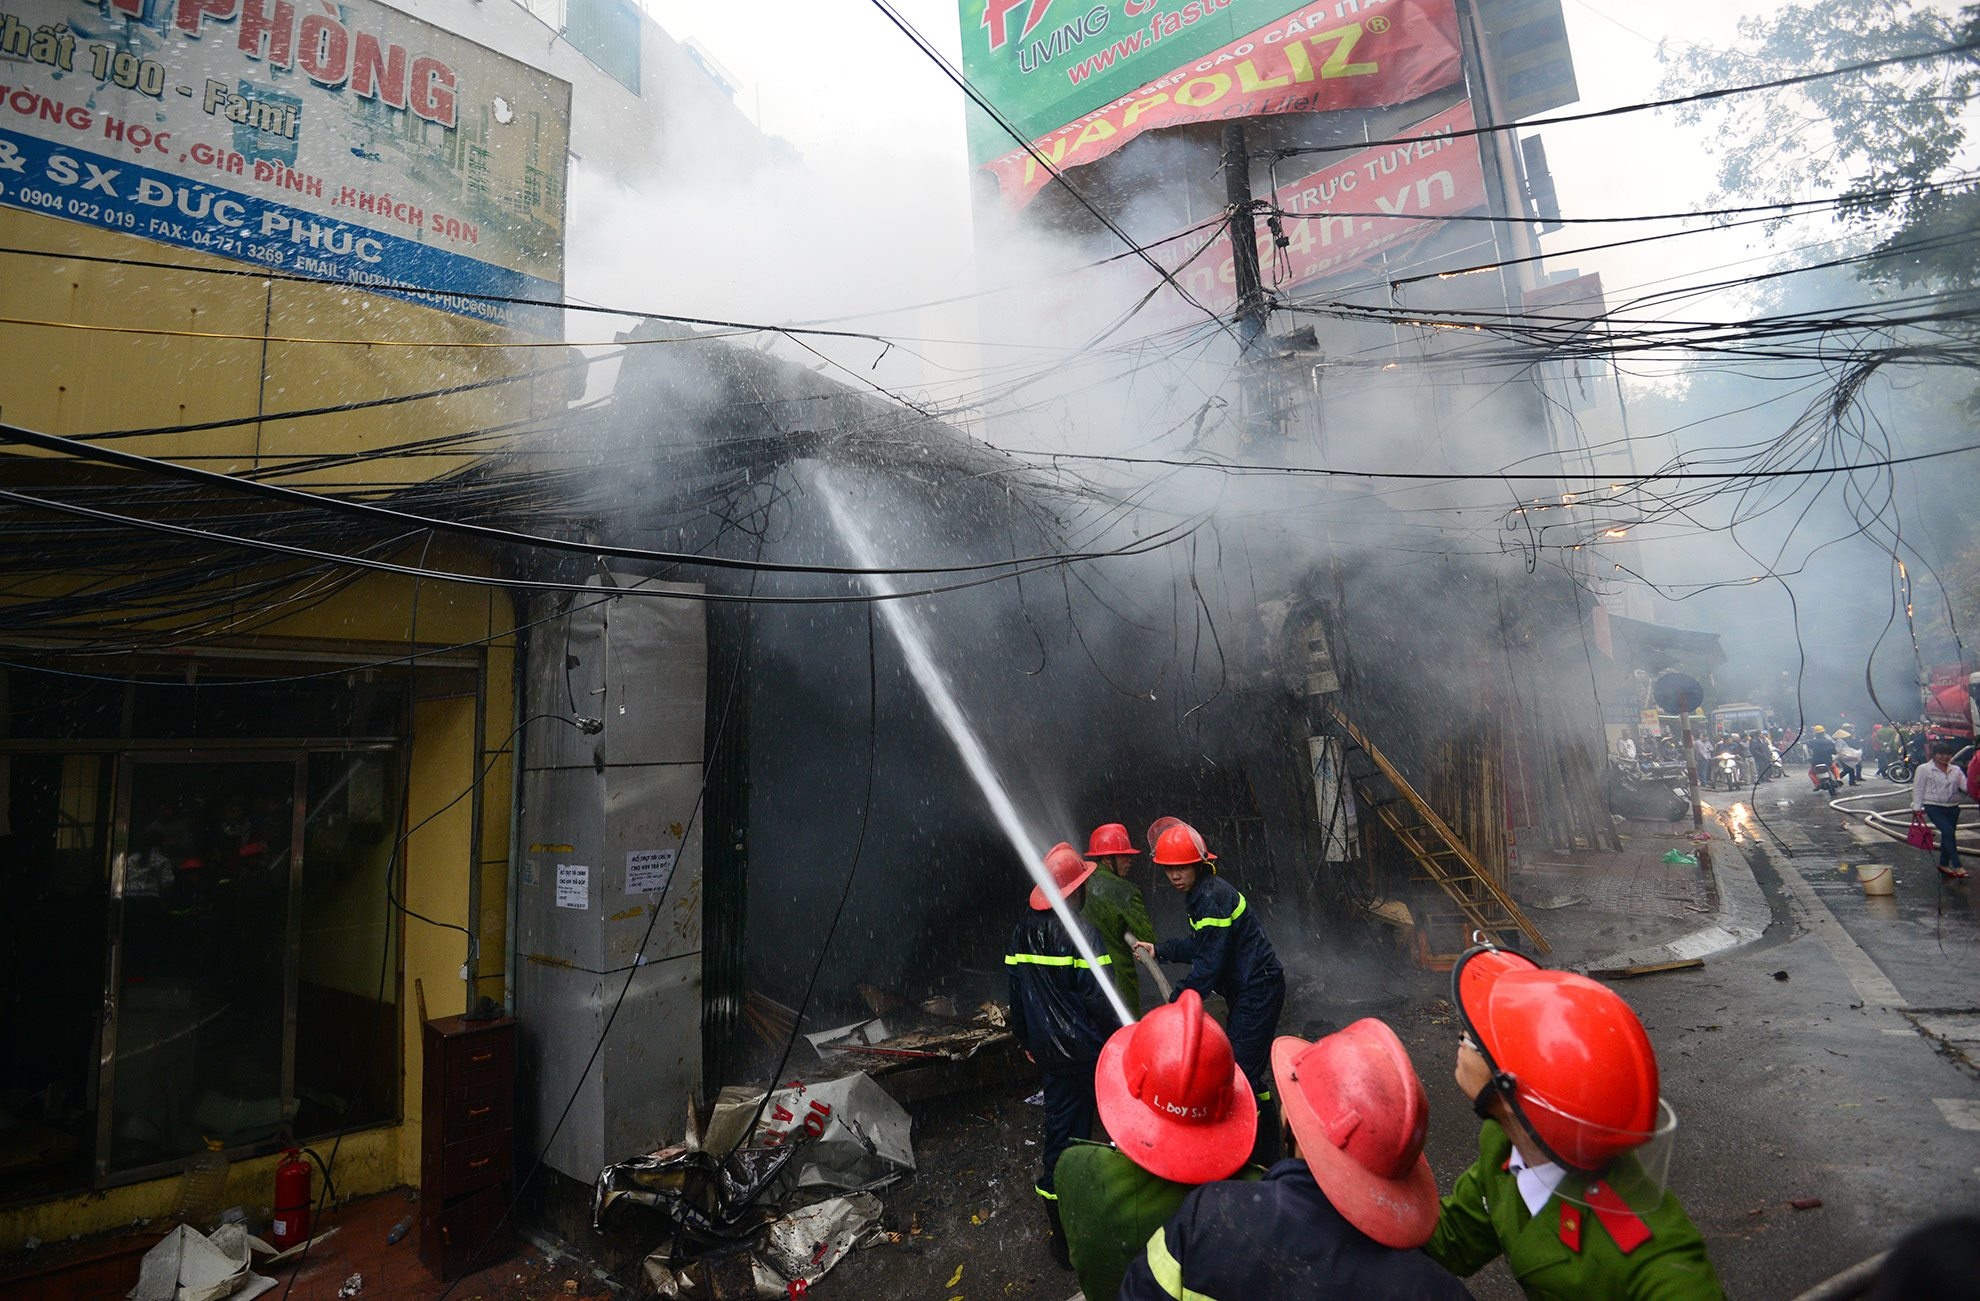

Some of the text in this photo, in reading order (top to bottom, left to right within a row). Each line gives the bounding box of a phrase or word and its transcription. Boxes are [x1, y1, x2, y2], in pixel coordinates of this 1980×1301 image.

[0, 14, 76, 71] hất
[89, 40, 166, 98] 190
[203, 78, 300, 140] Fami
[1019, 4, 1110, 75] LIVING
[1195, 43, 1254, 72] CAO
[1263, 10, 1326, 45] CẤP
[1261, 92, 1319, 114] Life!
[46, 155, 122, 198] SX
[136, 176, 245, 228] ĐỨC
[104, 117, 172, 154] HỌC
[254, 157, 322, 198] ĐÌNH
[432, 213, 480, 245] SẠN
[1287, 170, 1357, 213] TRỰC
[1363, 123, 1454, 181] TUYẾN
[20, 187, 64, 211] 0904
[68, 199, 100, 220] 022
[104, 209, 136, 229] 019
[150, 218, 188, 242] FAX:
[192, 230, 212, 247] 04
[247, 244, 284, 264] 3269
